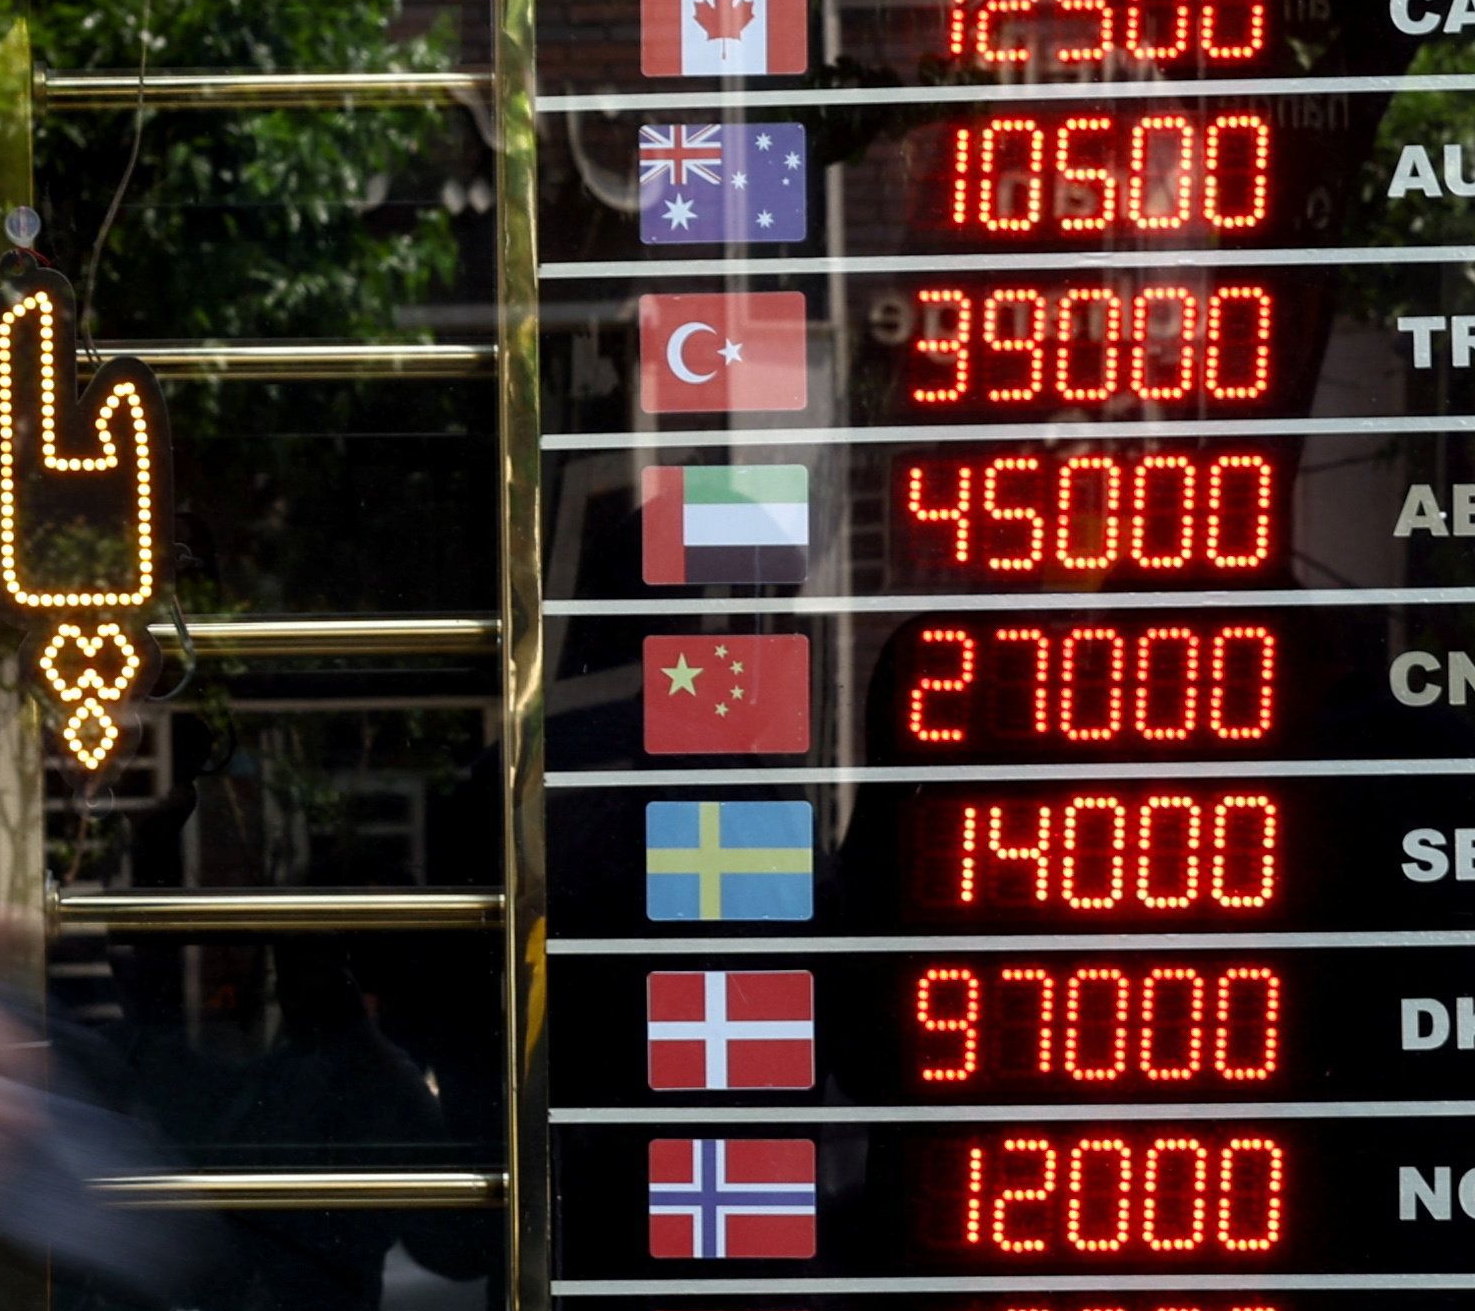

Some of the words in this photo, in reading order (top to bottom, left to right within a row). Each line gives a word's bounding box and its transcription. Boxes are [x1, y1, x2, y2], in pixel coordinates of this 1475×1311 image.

[951, 113, 1271, 233] 10500
[911, 285, 1273, 404] 39000
[906, 453, 1273, 572] 45000
[908, 625, 1276, 744] 27000
[959, 793, 1278, 911] 14000
[915, 966, 1281, 1083] 97000
[965, 1136, 1285, 1255] 12000
